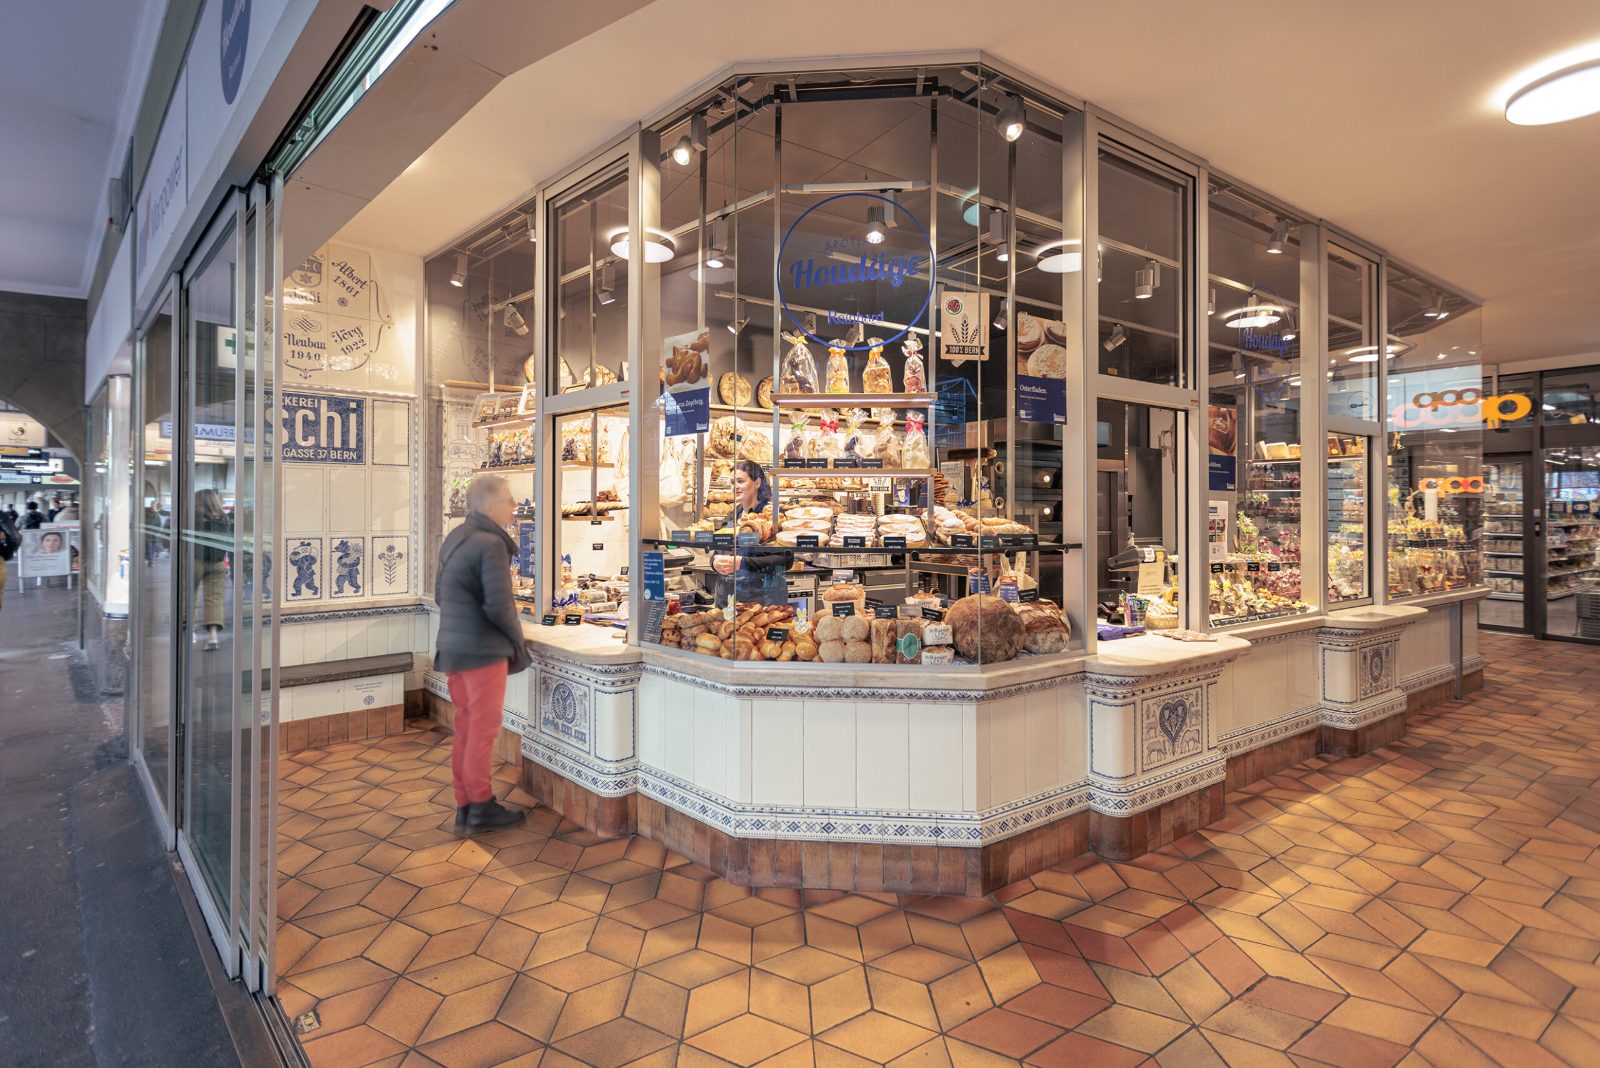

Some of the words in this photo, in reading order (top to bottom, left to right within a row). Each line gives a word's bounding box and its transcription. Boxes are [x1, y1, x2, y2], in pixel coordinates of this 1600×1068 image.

[331, 260, 369, 290] Albert
[332, 275, 361, 298] 1861
[284, 333, 327, 350] Neubau
[331, 325, 363, 344] Jörg
[290, 349, 321, 361] 1940
[340, 338, 367, 356] 1922
[317, 449, 327, 458] 37
[330, 450, 357, 460] BERN
